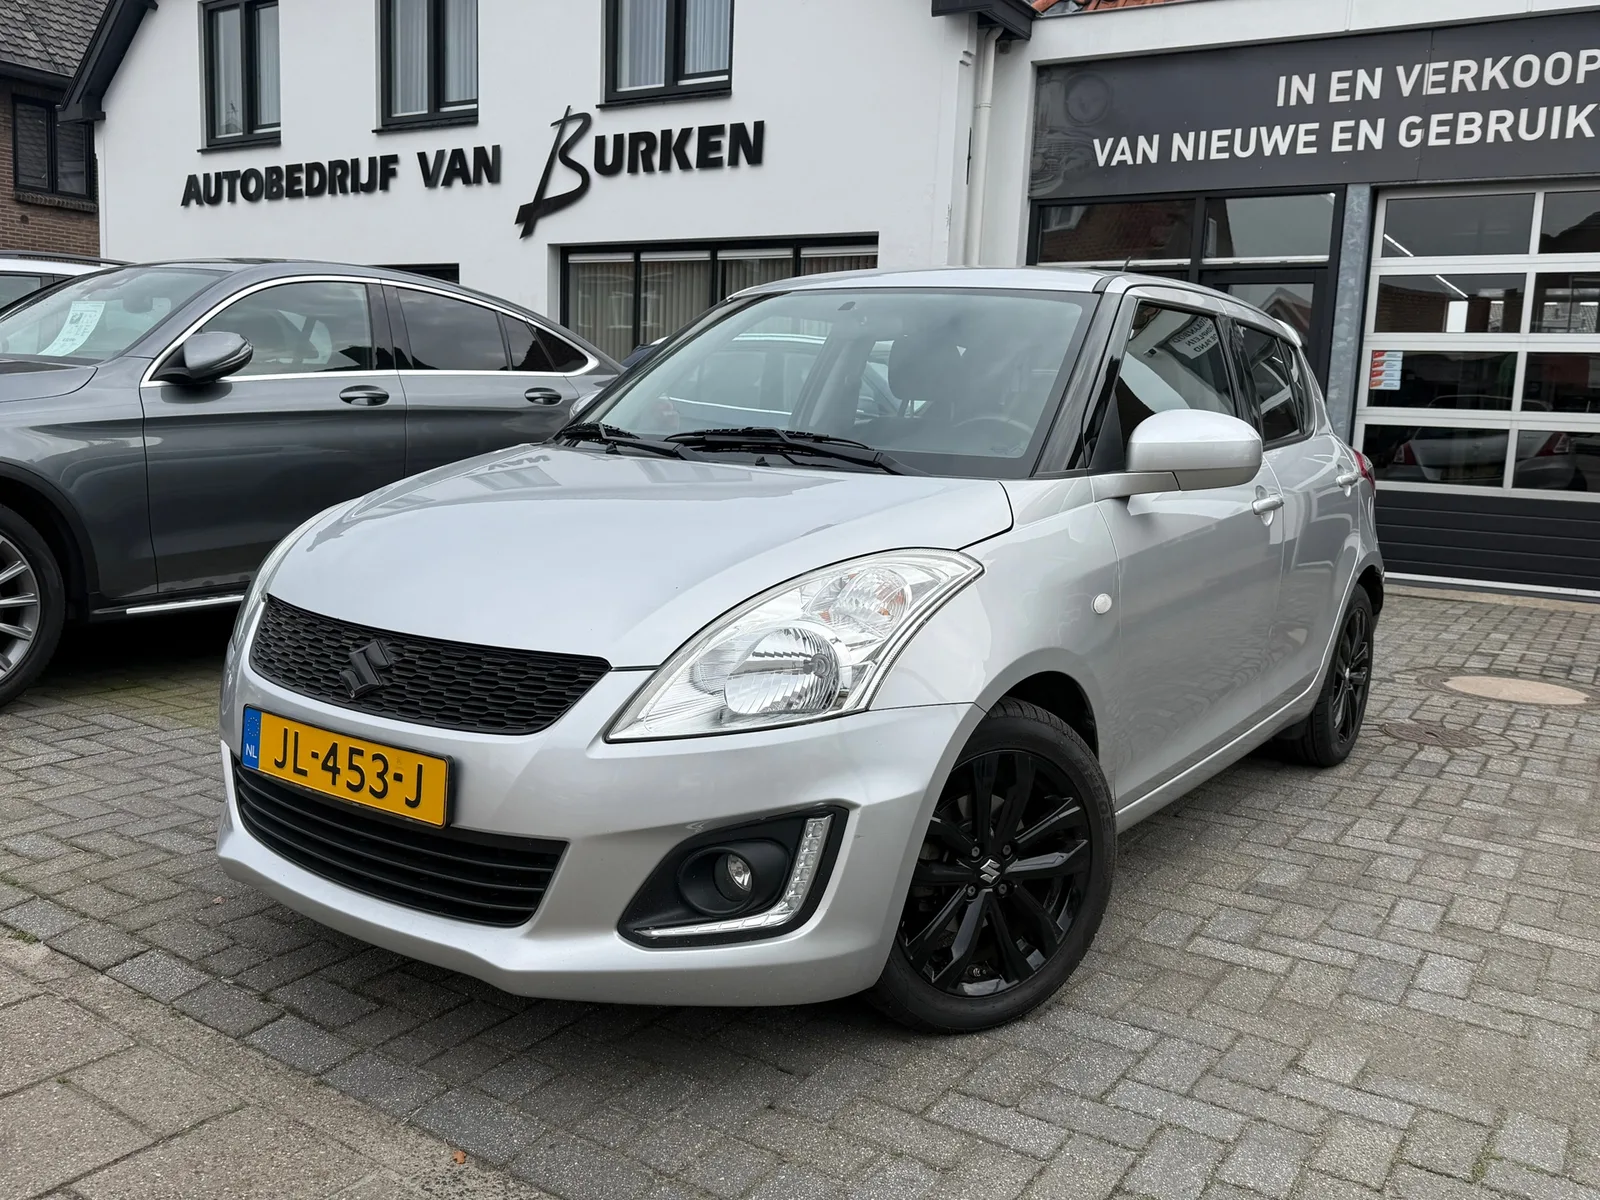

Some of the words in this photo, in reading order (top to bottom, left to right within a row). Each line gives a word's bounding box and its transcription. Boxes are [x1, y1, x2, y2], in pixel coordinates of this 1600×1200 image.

[1277, 73, 1316, 107] IN
[1329, 67, 1383, 103] EN
[1396, 49, 1600, 97] VERKOOP
[1093, 134, 1160, 167] VAN
[1171, 122, 1320, 163] NIEUWE
[1331, 118, 1385, 152] EN
[1398, 103, 1600, 148] GEBRUIK
[181, 154, 398, 207] AUTOBEDRIJF
[417, 144, 501, 188] VAN
[515, 105, 765, 239] BURKEN
[245, 743, 258, 759] NL
[274, 726, 423, 809] JL-453-J
